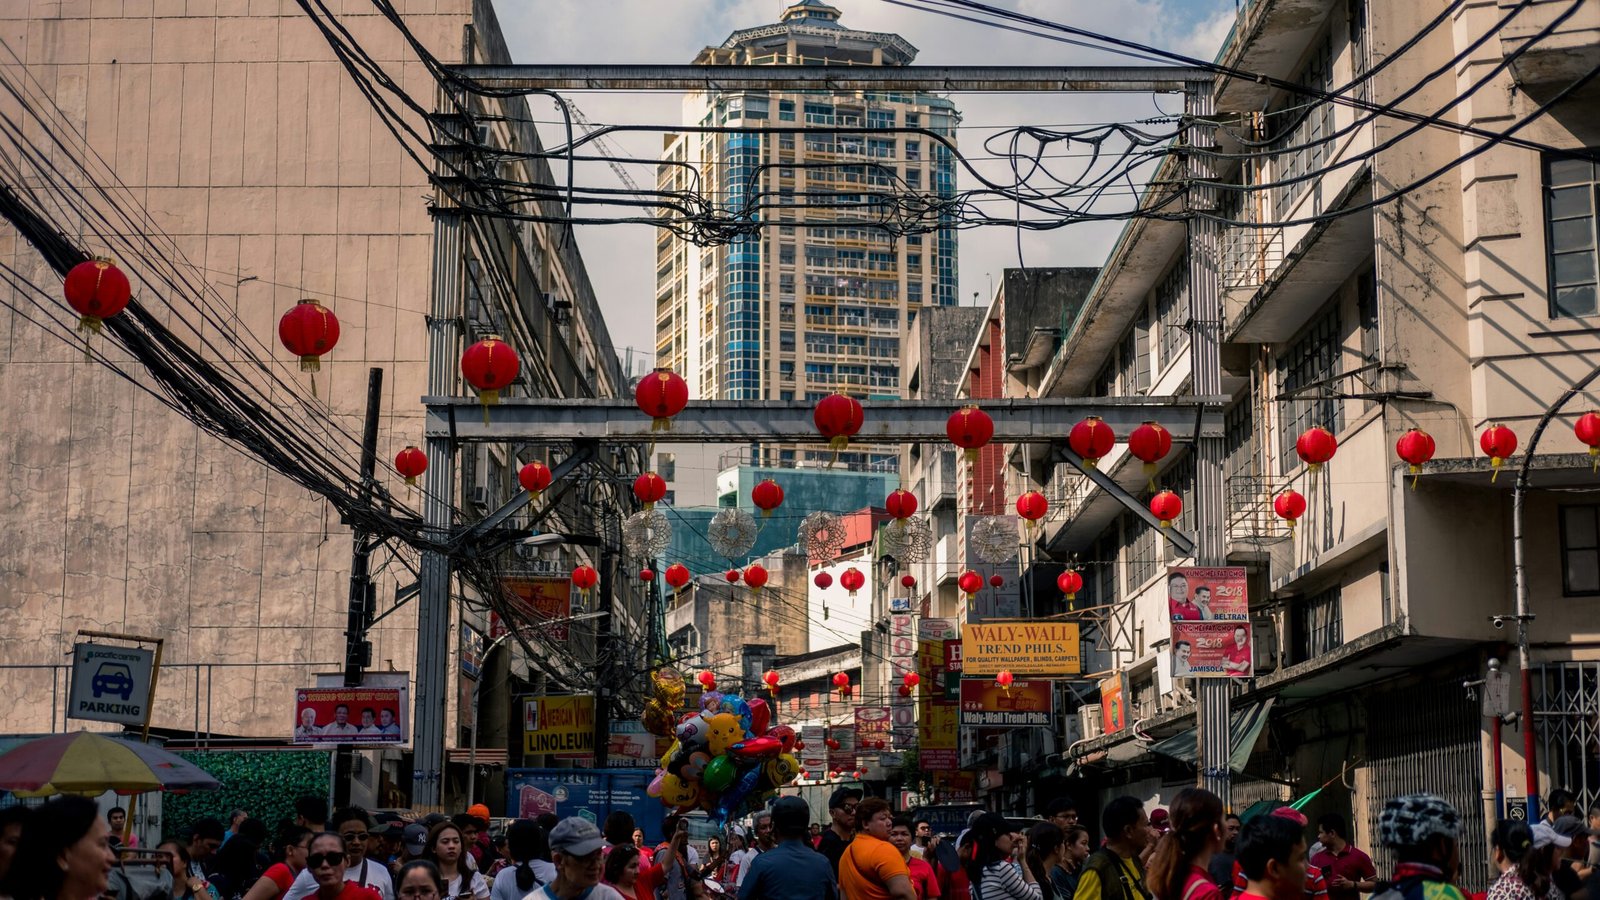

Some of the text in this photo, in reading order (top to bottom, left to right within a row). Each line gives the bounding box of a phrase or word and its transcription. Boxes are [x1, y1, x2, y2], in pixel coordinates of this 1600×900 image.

[1216, 585, 1243, 597] 2018
[971, 626, 1072, 642] WALY-WALL
[1194, 624, 1204, 632] HEI
[1205, 624, 1216, 632] FAT
[1216, 624, 1234, 632] CHOI
[976, 643, 1066, 654] TREND PHILS.
[1196, 637, 1223, 649] 2018
[1188, 665, 1225, 673] JAMISOLA
[80, 701, 140, 716] PARKING
[540, 700, 573, 730] AMERICAN
[963, 711, 1050, 725] Waly-Wall Trend Phils.
[529, 732, 593, 751] LINOLEUM
